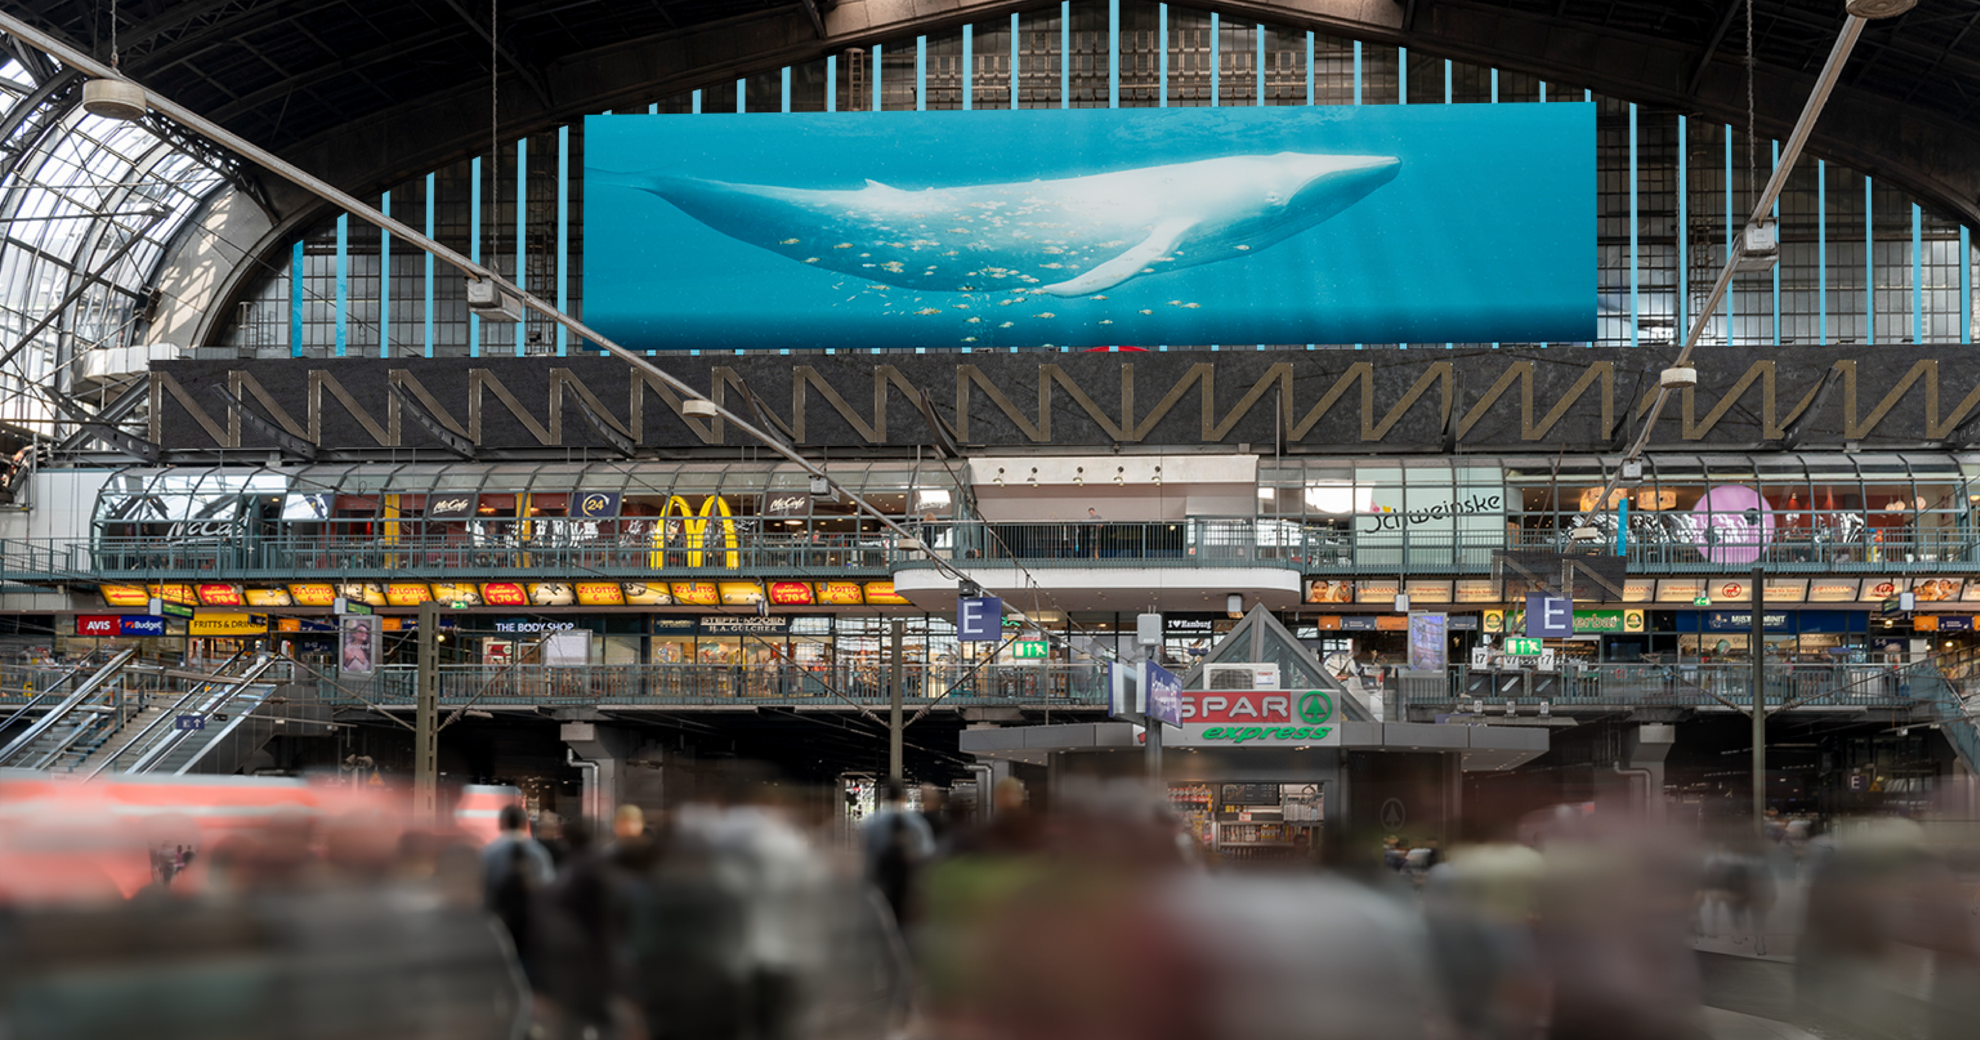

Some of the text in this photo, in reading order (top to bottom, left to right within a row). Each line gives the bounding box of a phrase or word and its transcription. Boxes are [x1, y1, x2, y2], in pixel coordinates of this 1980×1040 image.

[587, 499, 604, 510] 24
[489, 594, 511, 603] 1,70
[777, 593, 799, 602] 1,70
[963, 601, 984, 633] E
[1544, 597, 1565, 629] E
[87, 620, 110, 630] AVIS
[134, 620, 162, 631] Budget
[194, 620, 222, 628] FRITTS
[224, 620, 229, 628] &
[495, 622, 574, 632] THE BODY SHOP
[1182, 696, 1289, 718] SPAR
[1202, 726, 1332, 744] express
[1851, 775, 1860, 789] E
